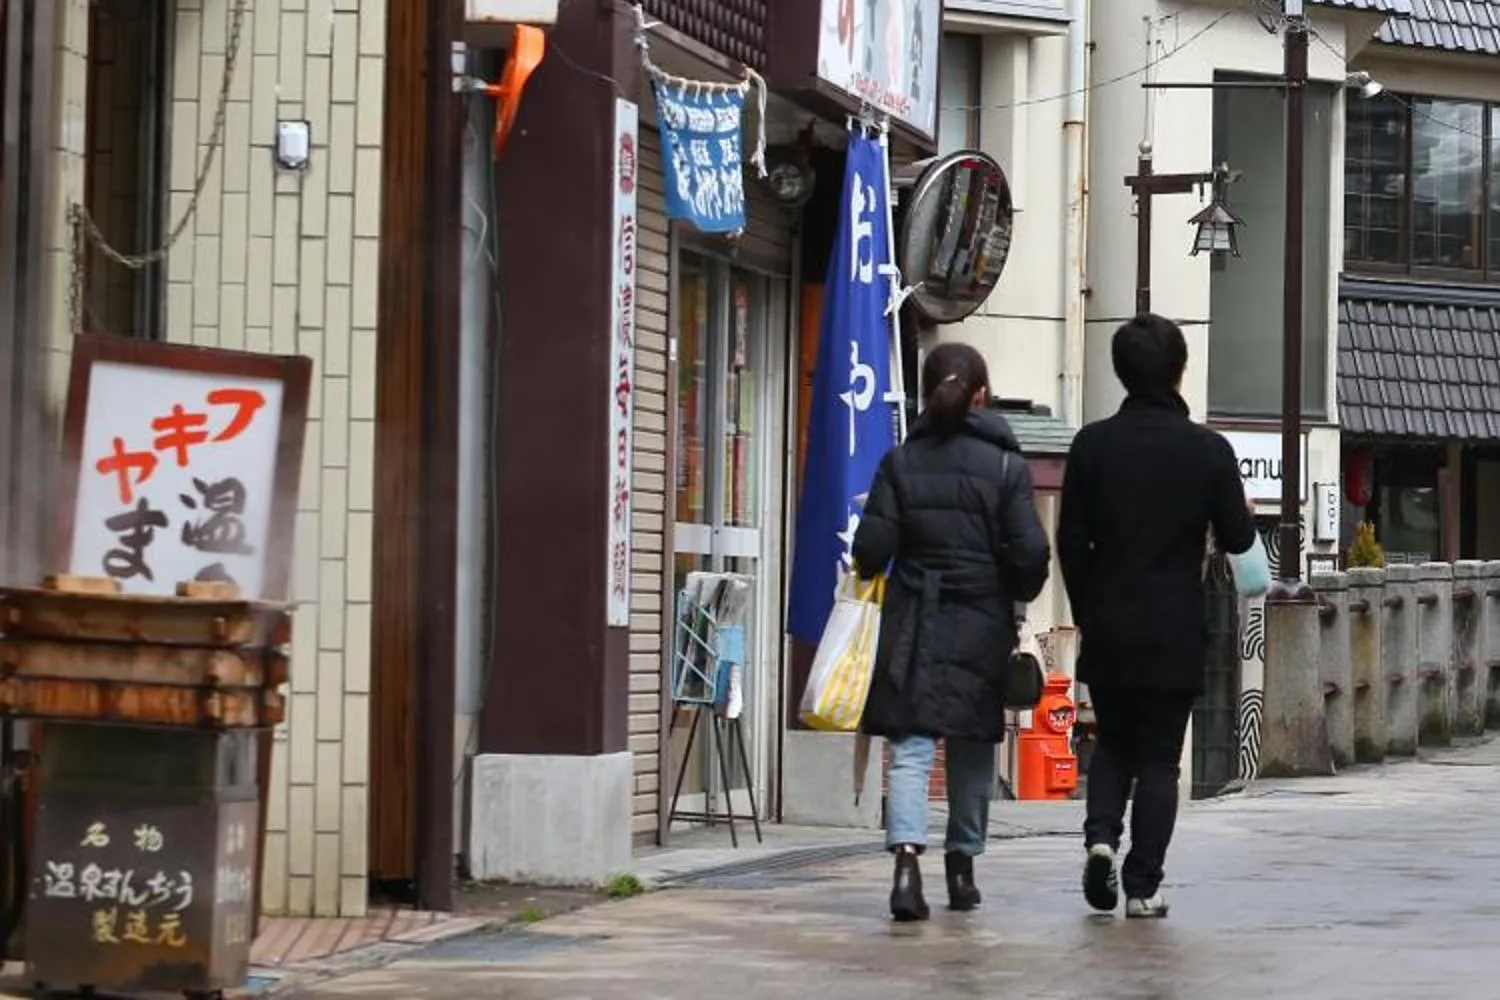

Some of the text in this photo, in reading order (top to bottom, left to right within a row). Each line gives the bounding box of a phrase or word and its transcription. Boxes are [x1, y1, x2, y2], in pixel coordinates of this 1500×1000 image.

[1327, 489, 1337, 531] bar
[43, 860, 194, 911] 温泉まんぢう
[92, 906, 188, 947] 製造元
